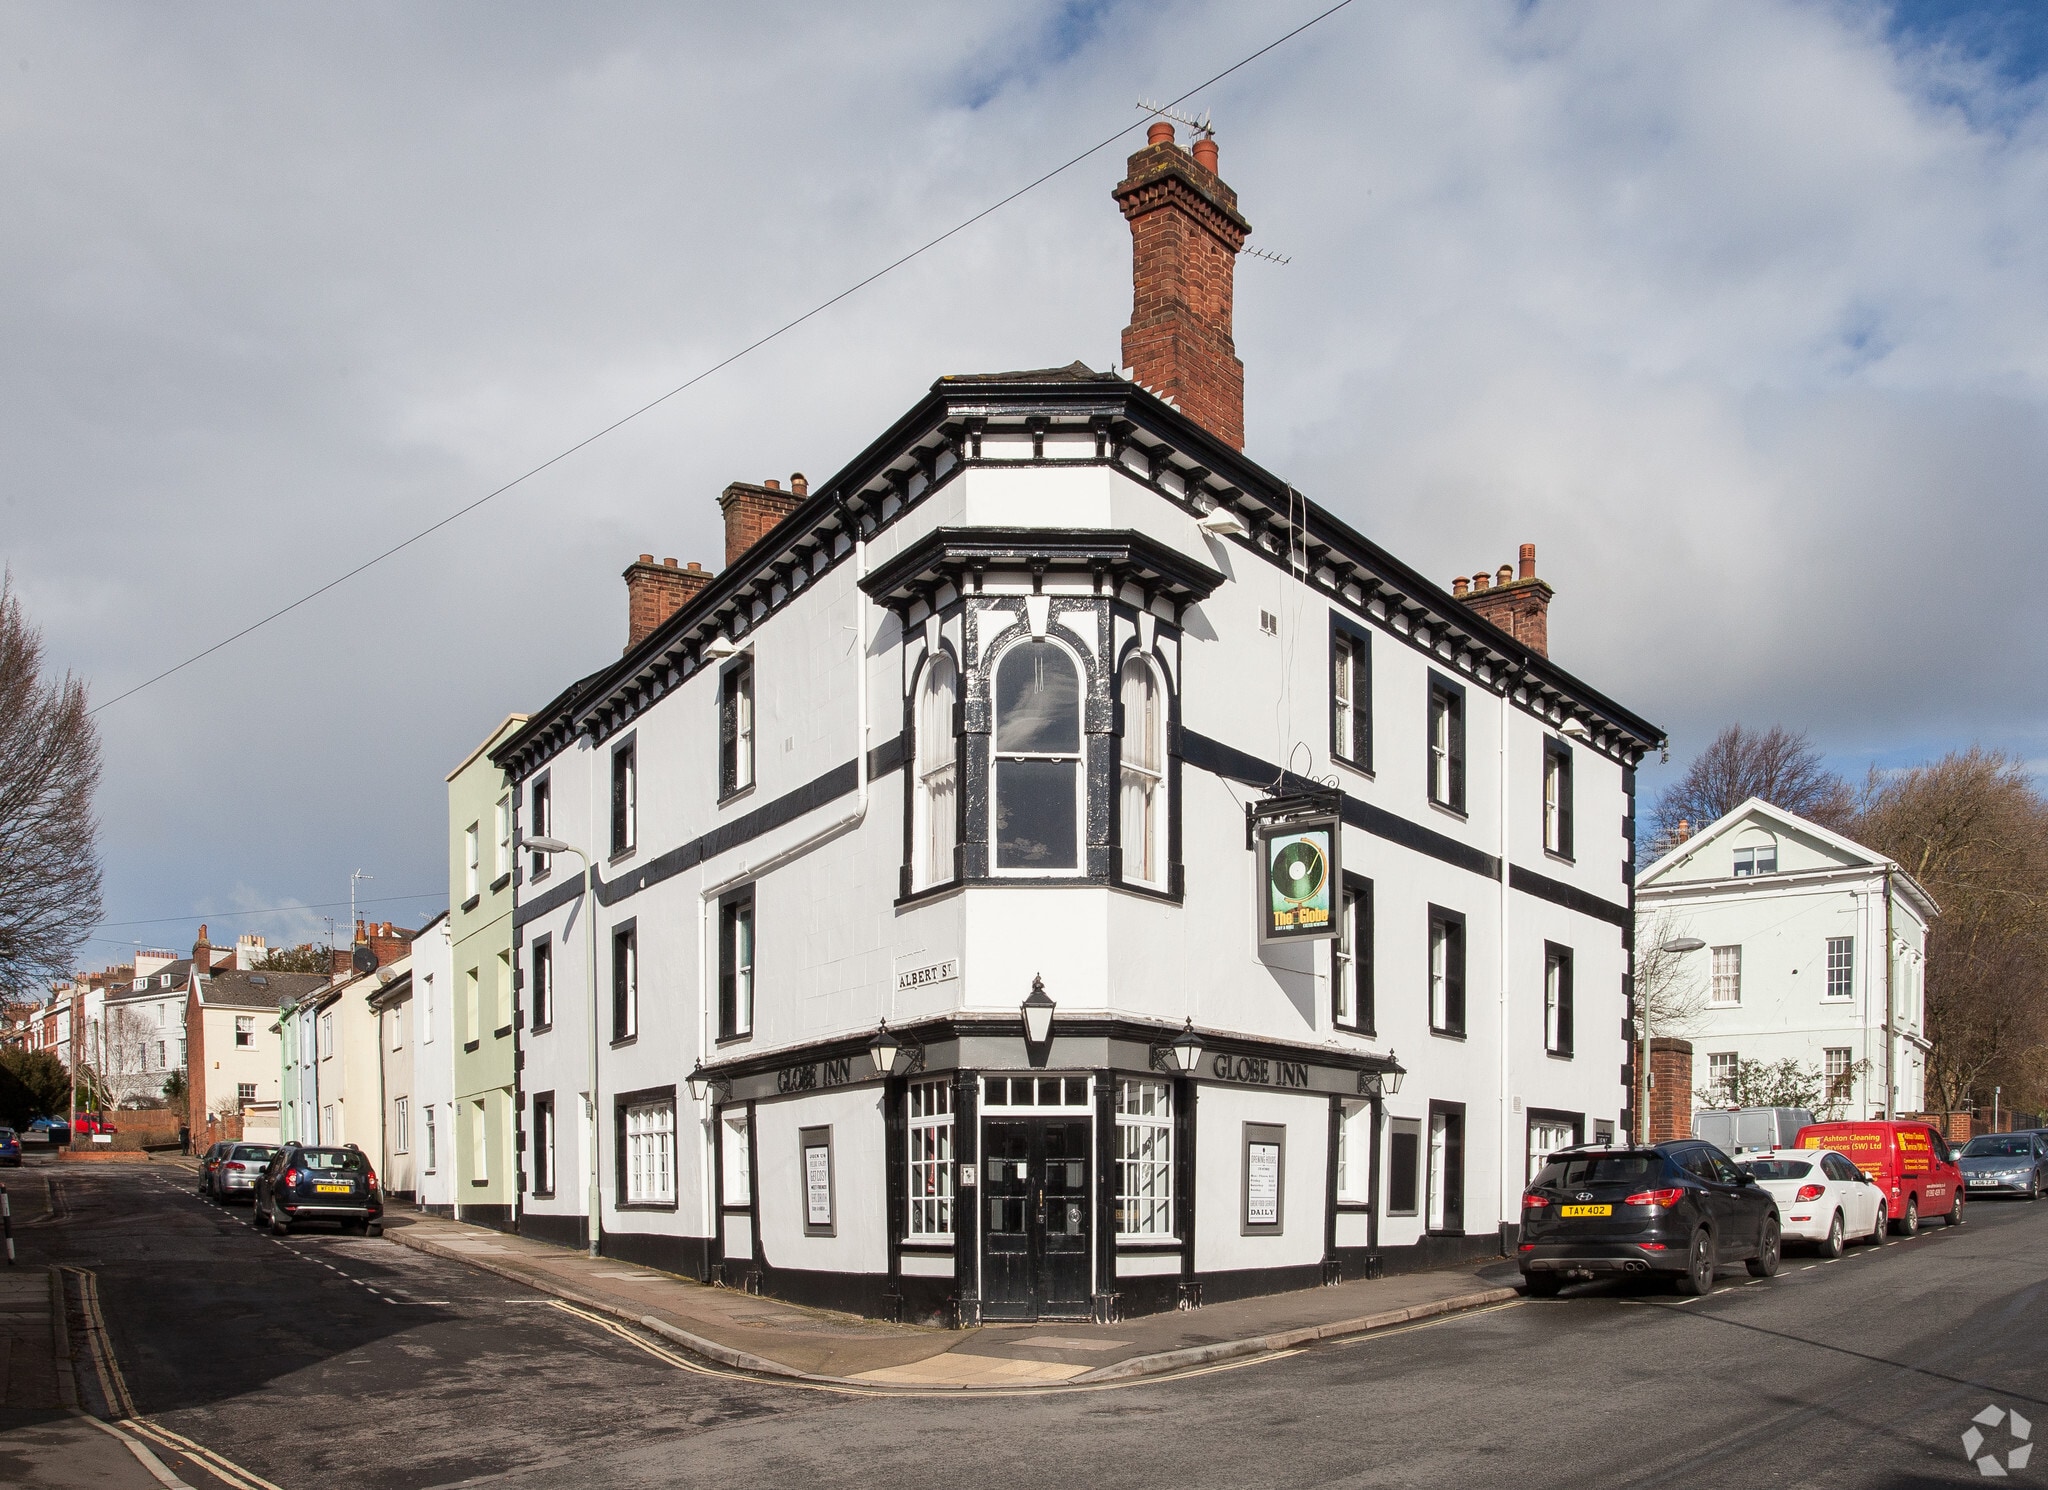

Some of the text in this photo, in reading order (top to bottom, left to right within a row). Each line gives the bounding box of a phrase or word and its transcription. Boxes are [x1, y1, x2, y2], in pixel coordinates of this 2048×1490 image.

[1274, 910, 1292, 926] The
[1300, 908, 1328, 924] Globe
[899, 967, 937, 988] ALBERT
[777, 1057, 852, 1093] GLOBE INN
[1213, 1054, 1309, 1088] GLOBE INN
[1849, 1134, 1880, 1142] Cleaning
[1851, 1143, 1868, 1151] (SW)
[1569, 1206, 1605, 1215] TAY 402
